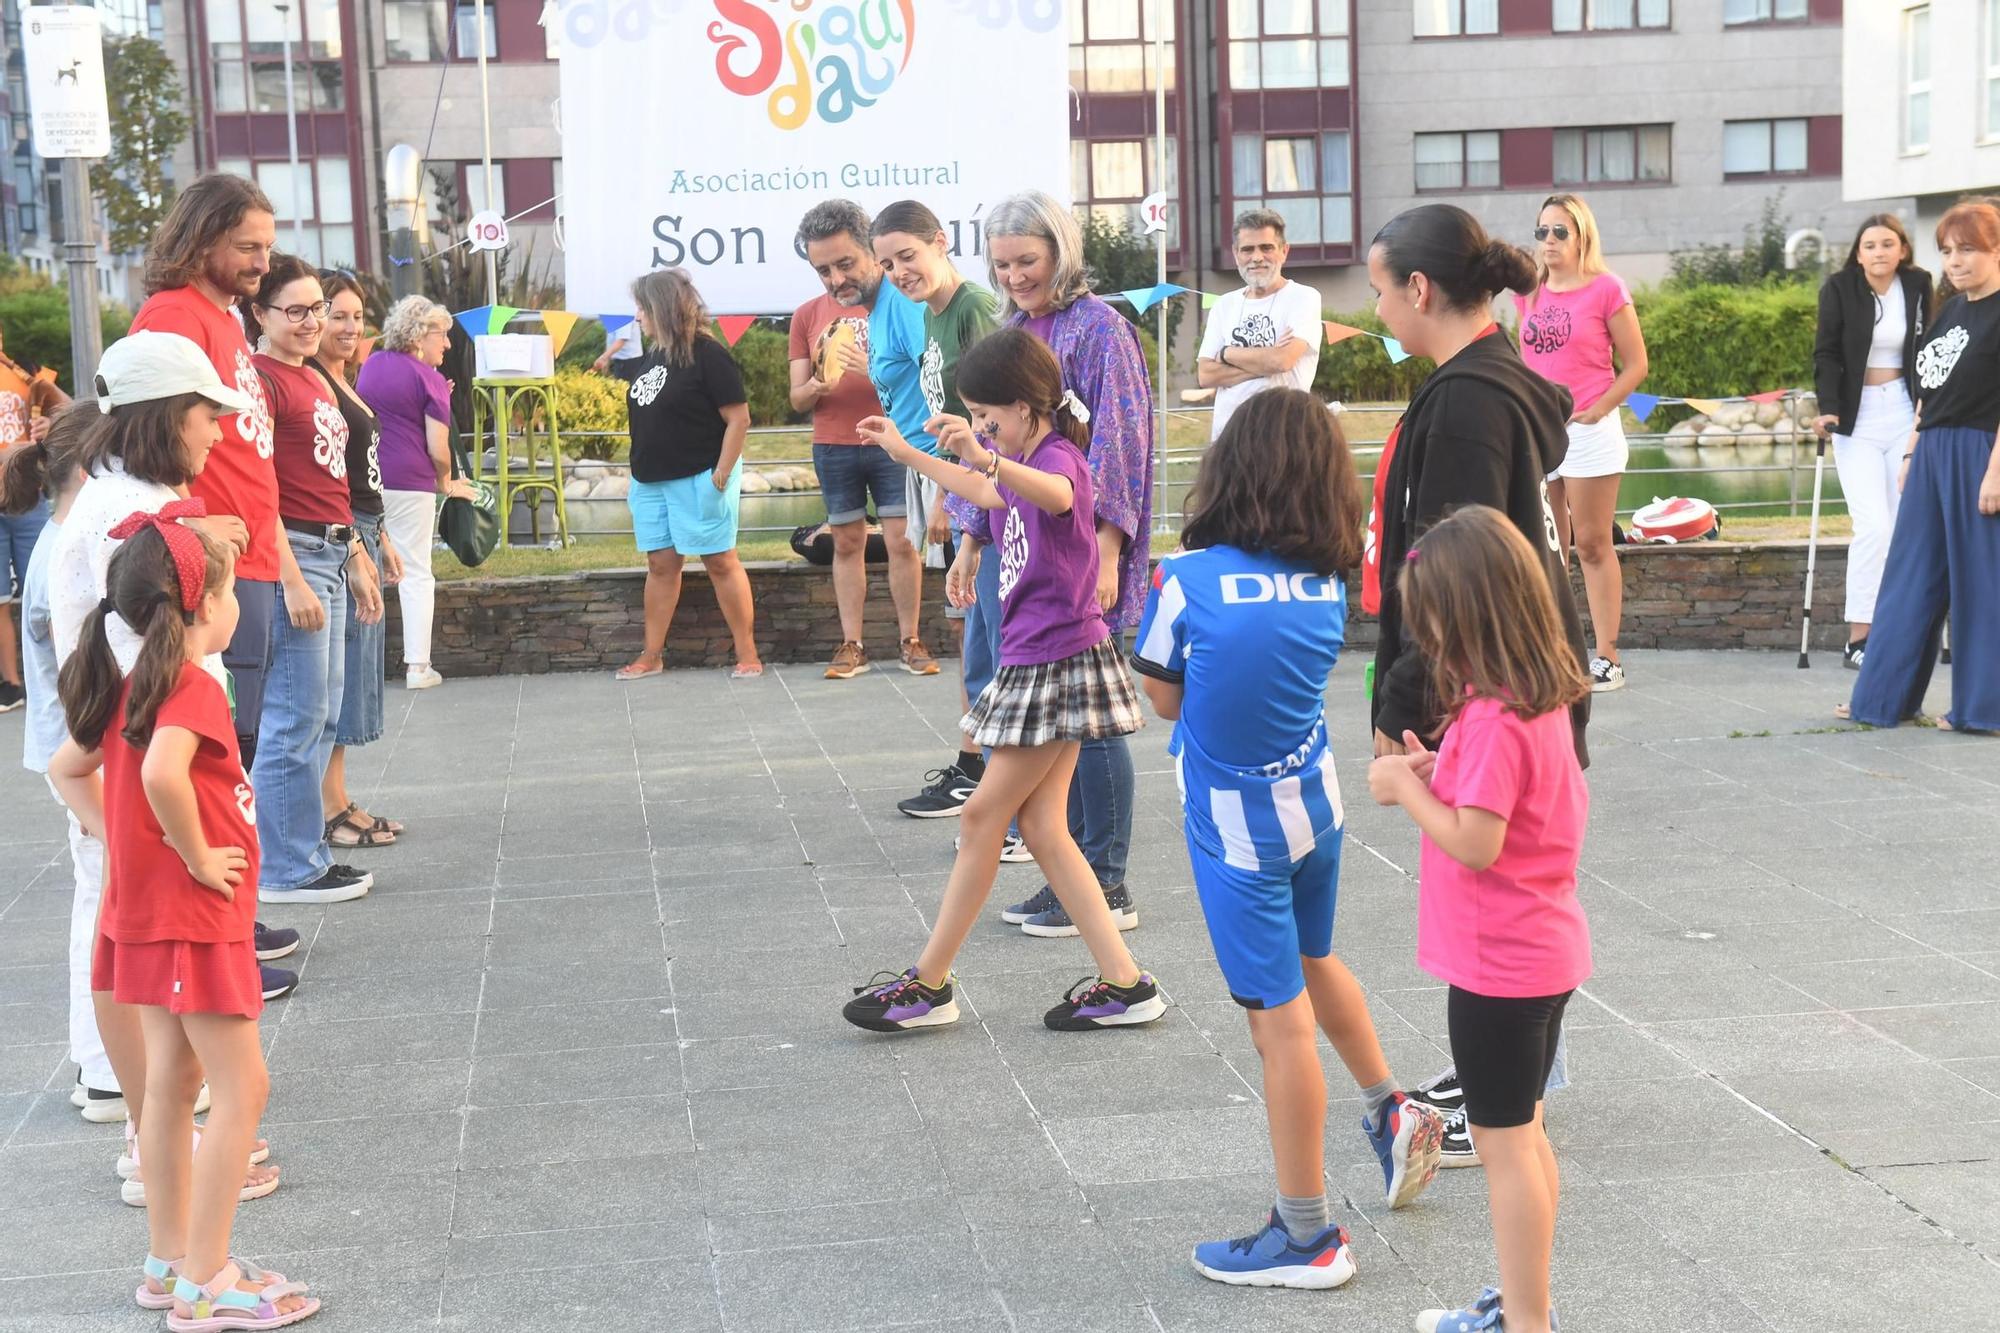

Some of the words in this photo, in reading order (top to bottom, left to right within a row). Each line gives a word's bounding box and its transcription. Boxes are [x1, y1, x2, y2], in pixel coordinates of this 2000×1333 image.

[668, 165, 829, 194] Asociación
[840, 161, 959, 188] Cultural
[651, 214, 766, 268] Son
[1219, 572, 1340, 605] DIGI
